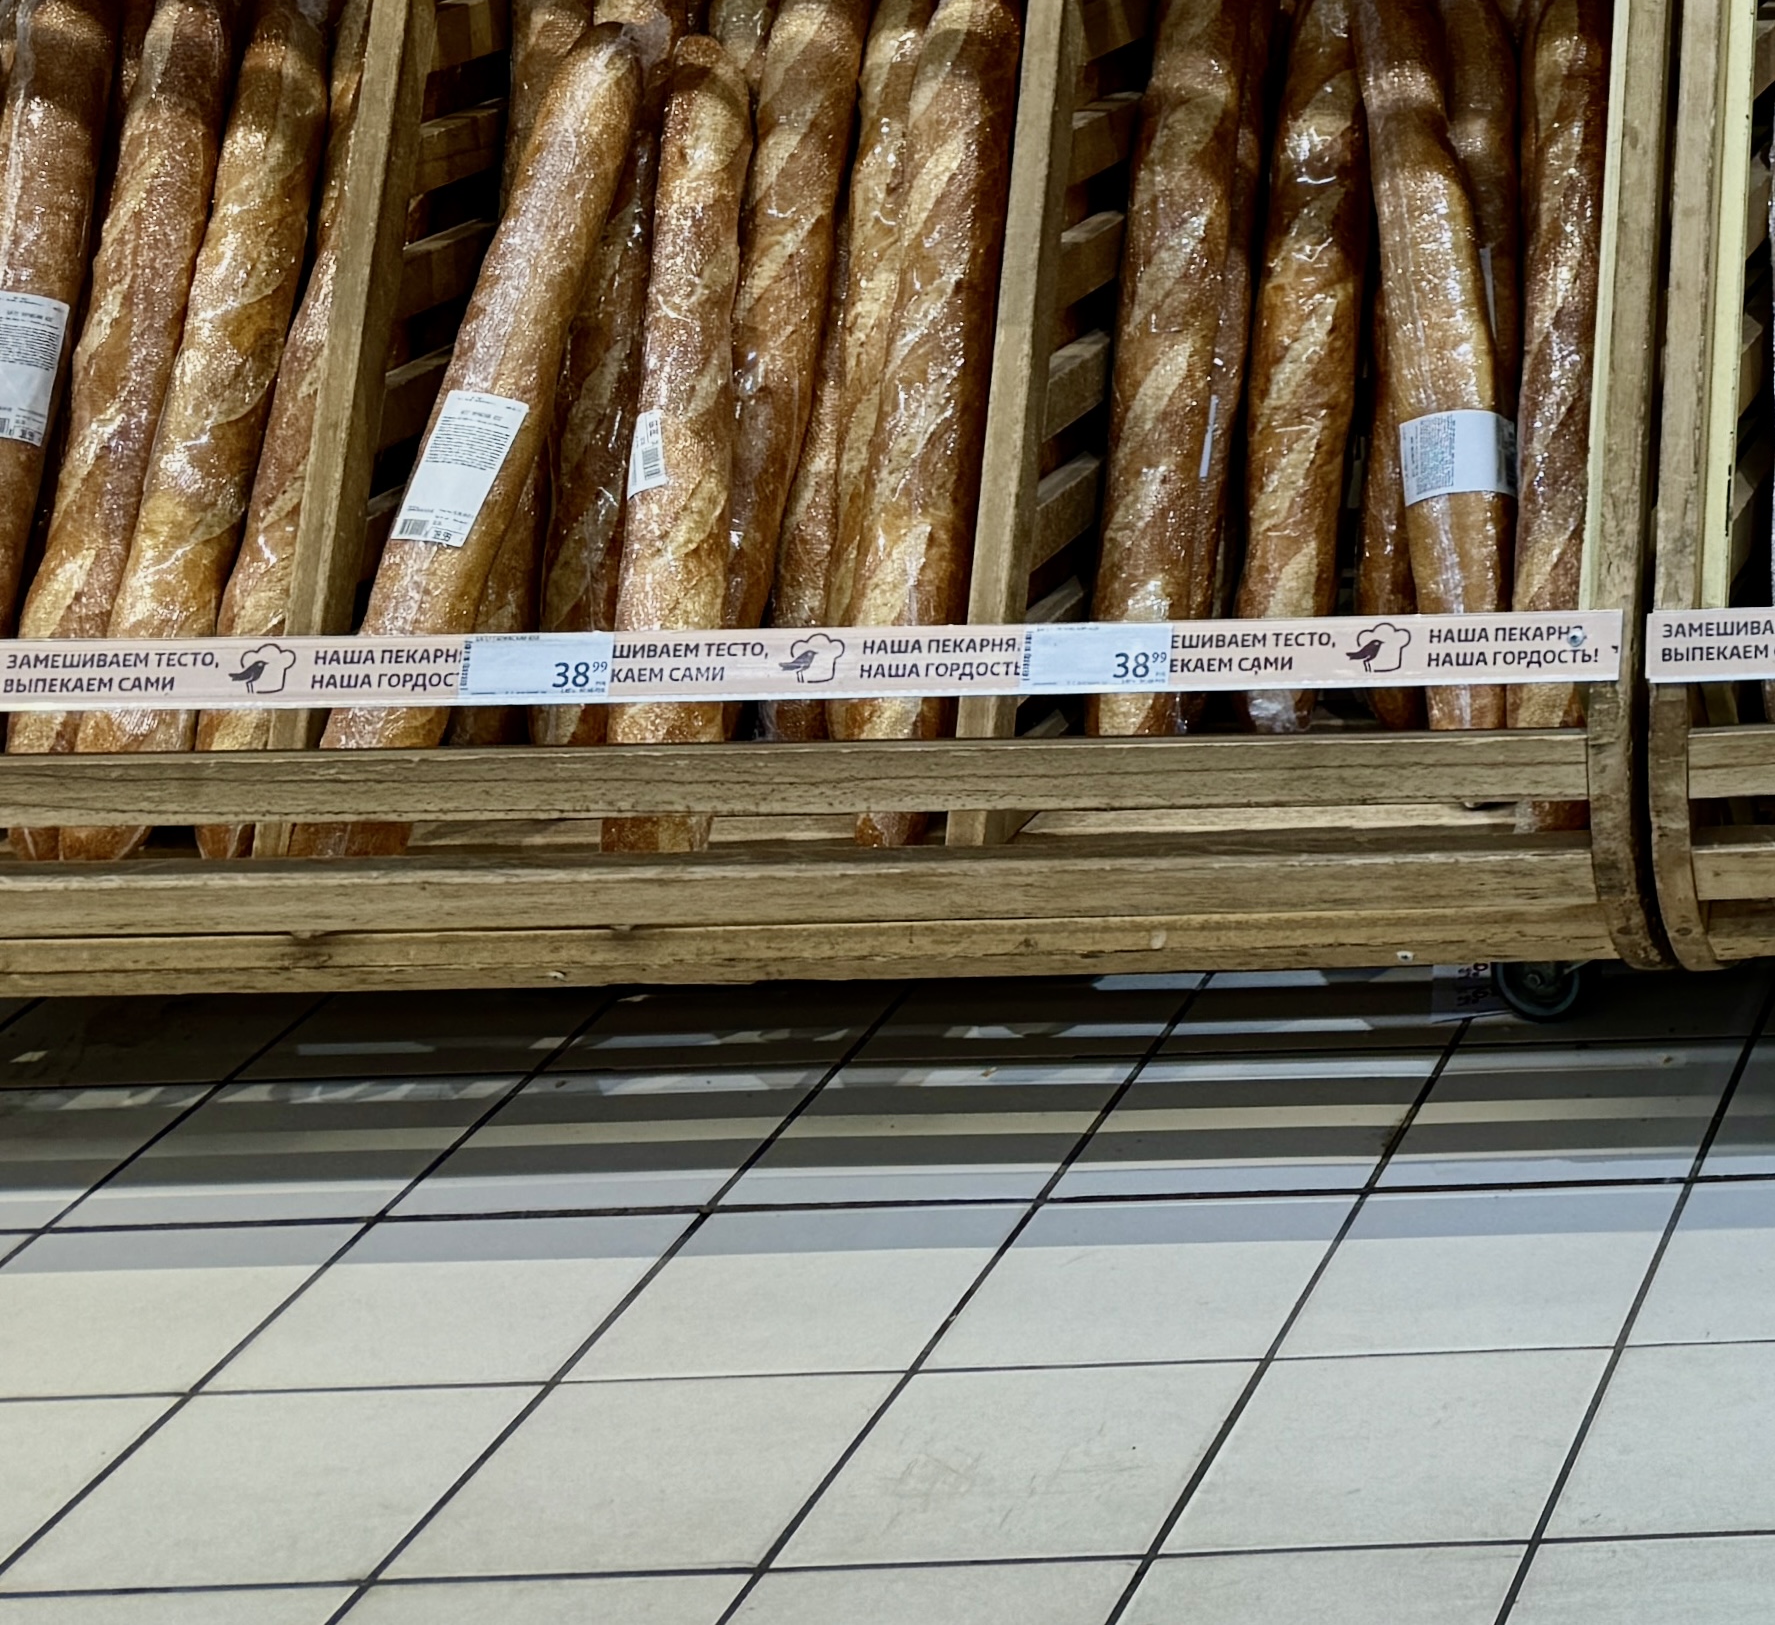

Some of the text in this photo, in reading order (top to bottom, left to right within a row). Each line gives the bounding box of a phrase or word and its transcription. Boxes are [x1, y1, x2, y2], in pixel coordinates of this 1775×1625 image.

[1429, 628, 1489, 643] НАША
[863, 638, 1020, 654] НАША ПЕКАРНЯ.
[1662, 644, 1768, 662] ВЫПЕКАЕМ
[7, 652, 218, 669] ЗАМЕШИВАЕМ ТЕСТО,
[1428, 648, 1598, 668] НАША ГОРДОСТЬ!
[860, 664, 920, 678] НАША
[3, 677, 174, 693] ВЫПЕКАЕМ САМИ
